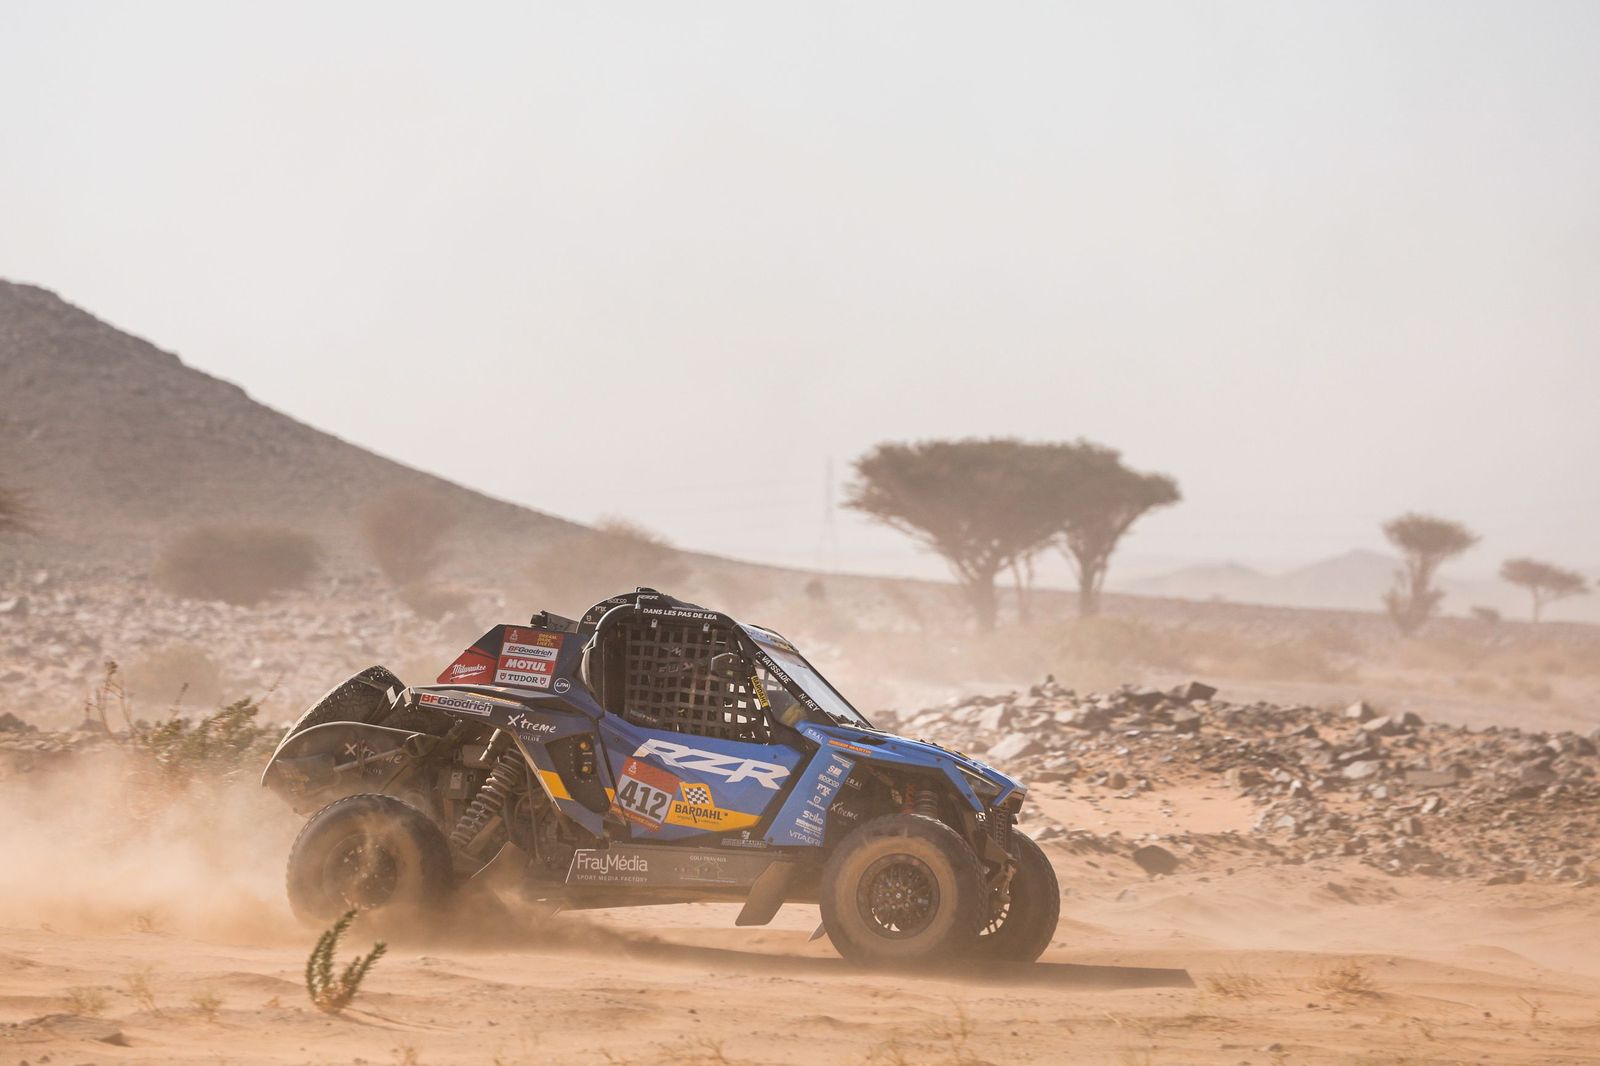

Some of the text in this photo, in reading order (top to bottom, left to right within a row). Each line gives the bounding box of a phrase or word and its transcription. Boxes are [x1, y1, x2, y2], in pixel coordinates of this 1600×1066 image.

[507, 645, 553, 657] BFGoodrich
[451, 664, 486, 675] Milwaukee
[505, 659, 546, 671] MOTUL
[761, 655, 792, 684] VAYSSADE
[508, 674, 538, 684] TUDOR
[421, 694, 492, 712] BFGoodrich
[804, 698, 820, 712] REY
[632, 738, 791, 790] RZR
[620, 779, 668, 821] 412
[674, 804, 722, 821] BARDAHL
[802, 810, 824, 825] Stilo
[577, 853, 648, 874] FrayMédia
